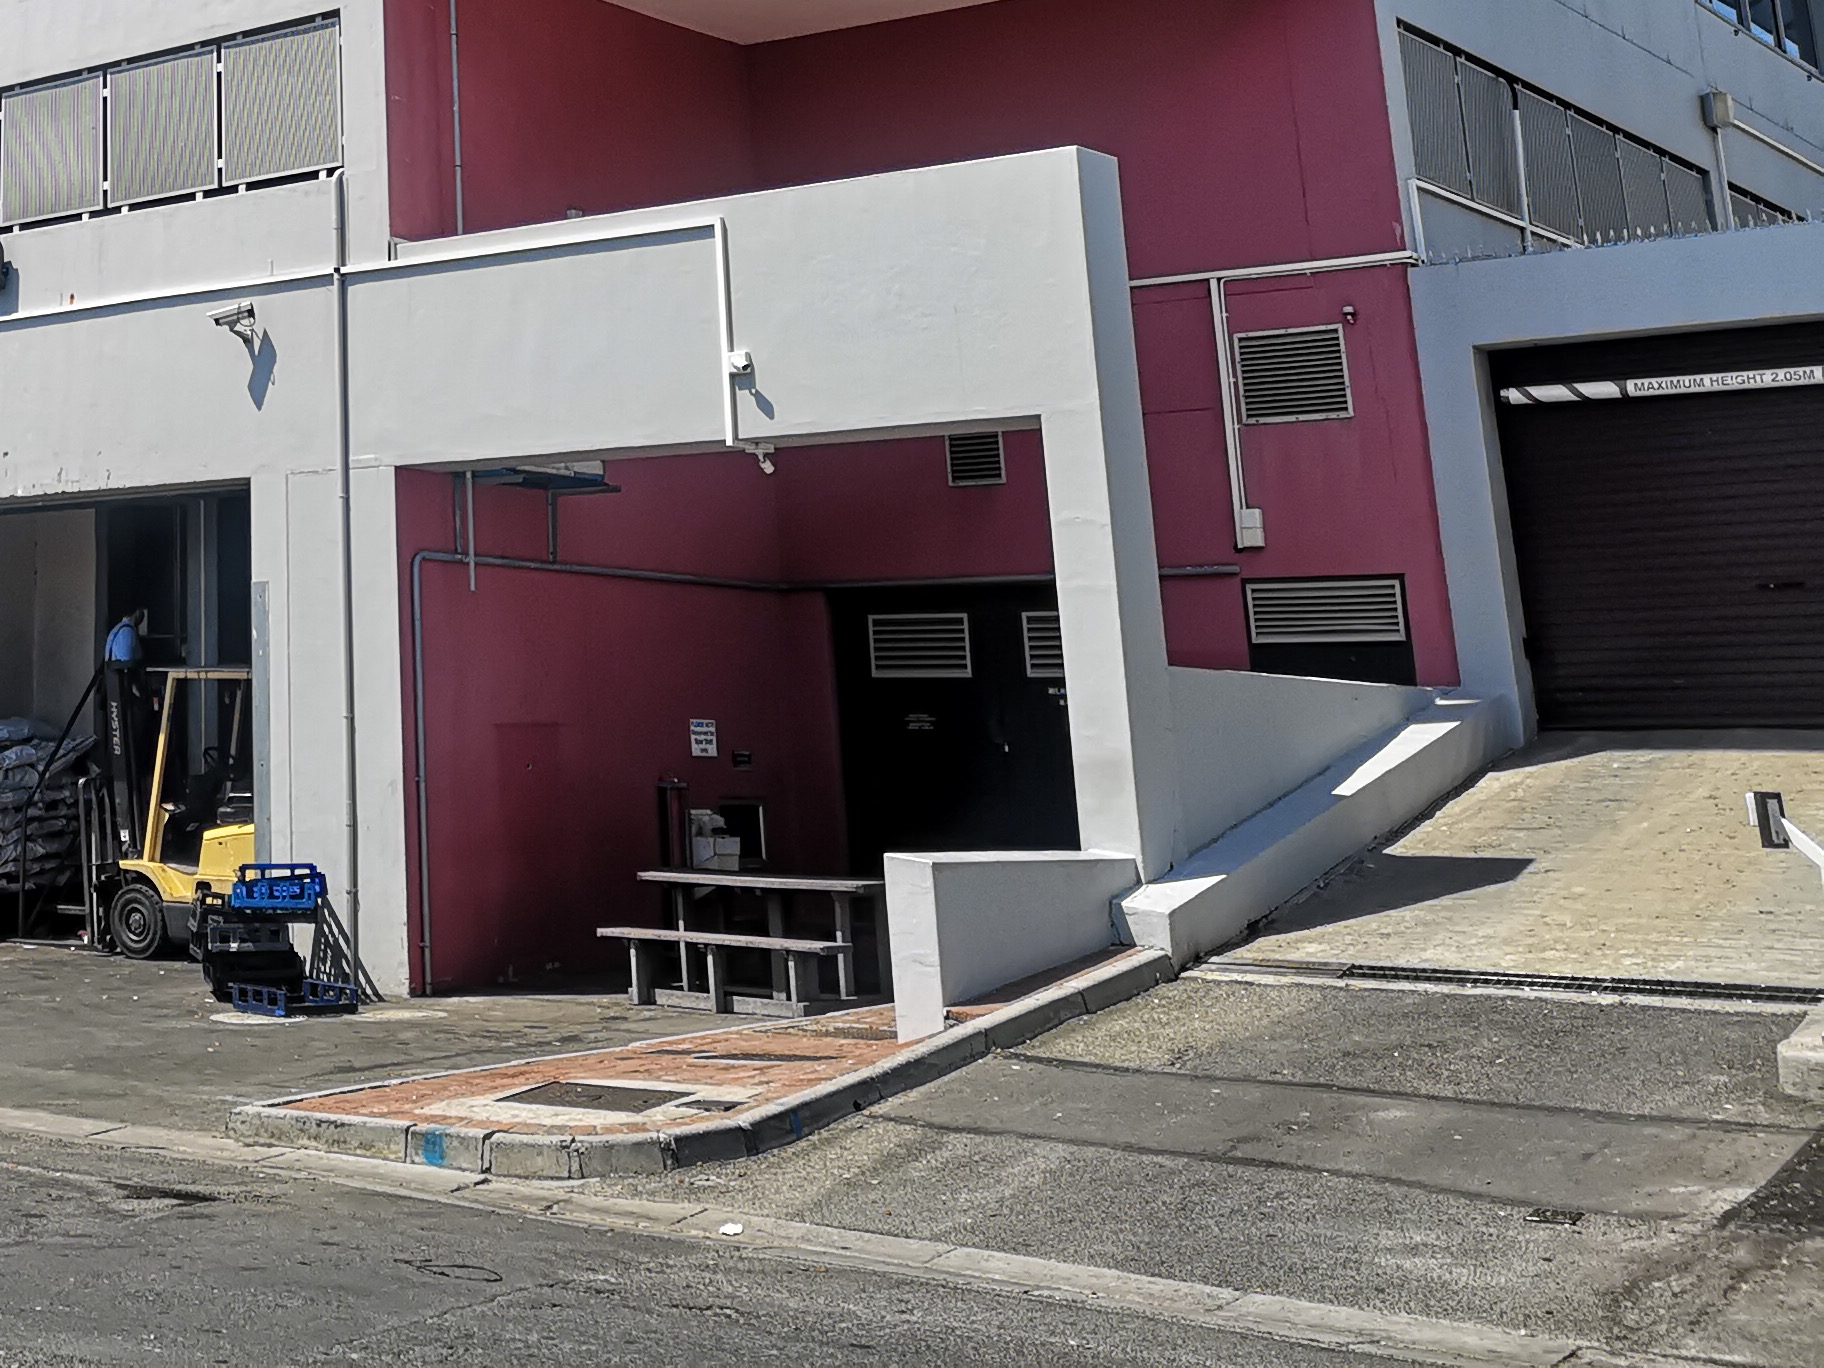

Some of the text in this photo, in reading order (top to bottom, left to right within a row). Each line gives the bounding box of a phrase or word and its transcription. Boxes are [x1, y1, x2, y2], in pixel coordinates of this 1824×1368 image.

[1633, 369, 1816, 393] MAXIMUM HEIGHT 2.05M
[110, 701, 121, 755] HYSTER
